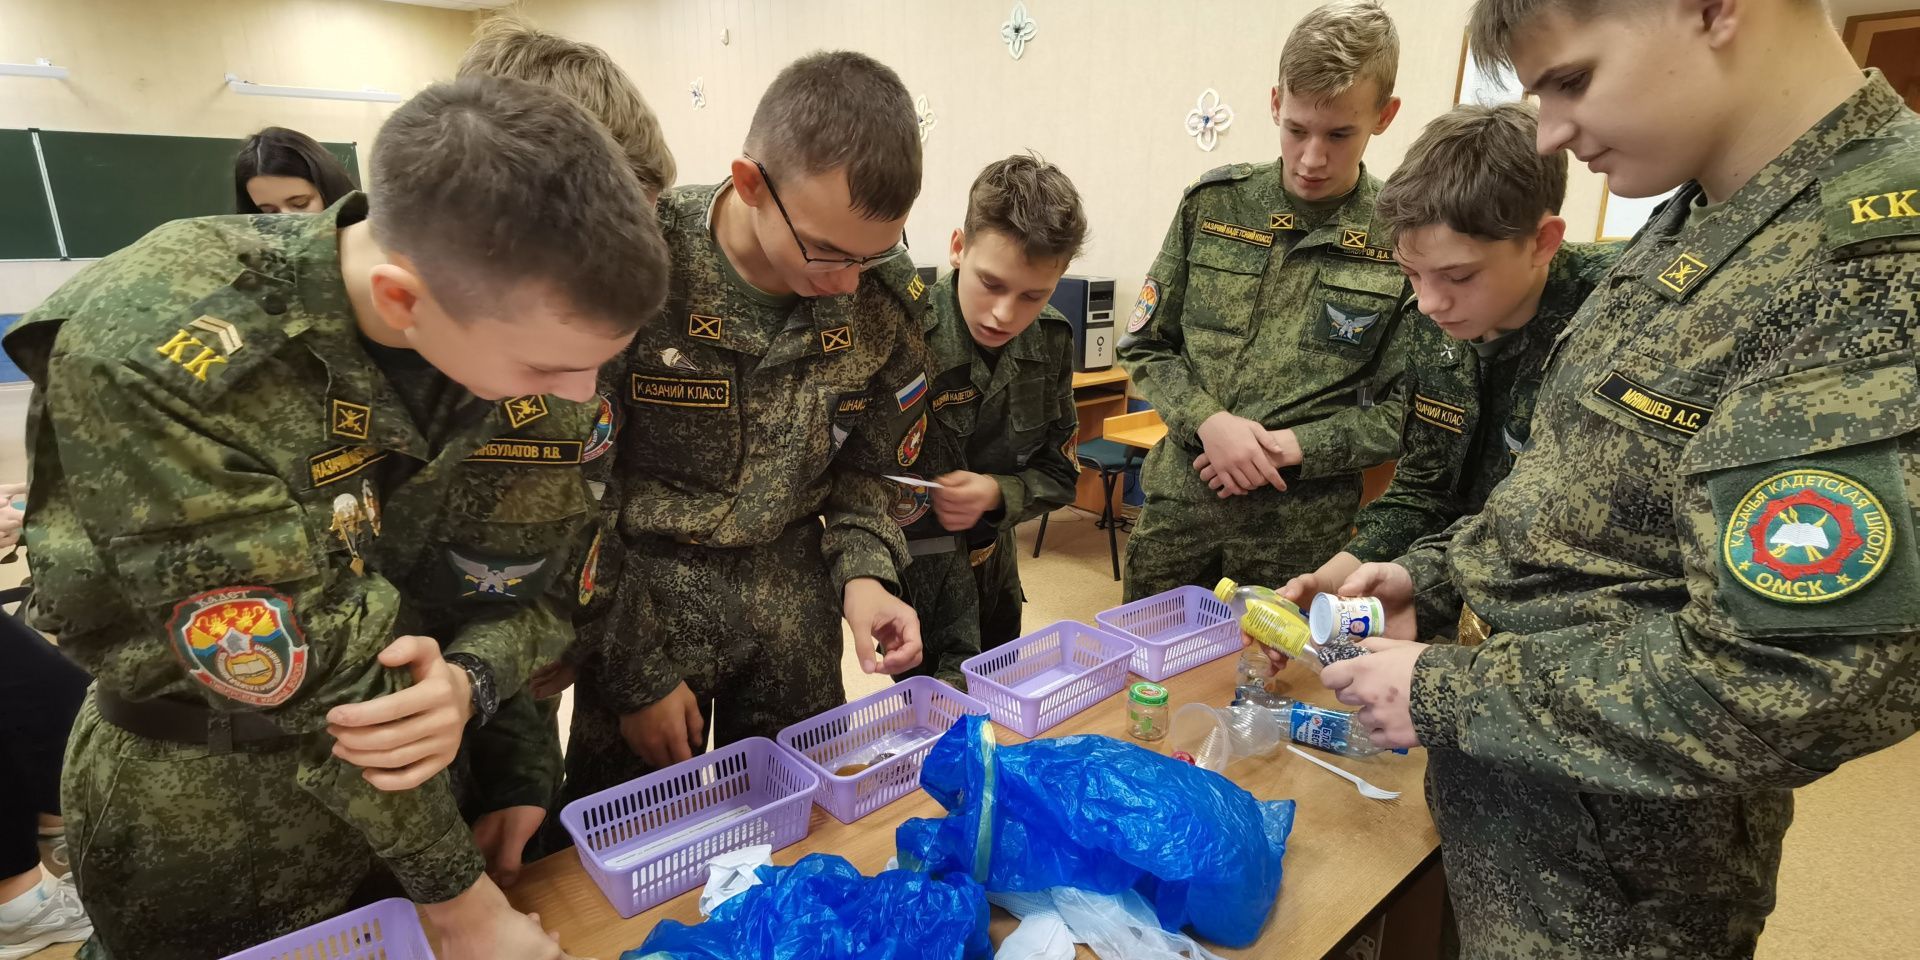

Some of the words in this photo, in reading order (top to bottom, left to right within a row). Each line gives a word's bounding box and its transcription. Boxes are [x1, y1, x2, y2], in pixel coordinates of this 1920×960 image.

[1848, 189, 1920, 224] КК
[907, 273, 926, 300] КК
[156, 328, 227, 382] КК
[637, 381, 684, 398] КАЗАЧИЙ
[687, 386, 724, 400] КЛАСС
[1673, 409, 1701, 429] А.С.
[474, 443, 539, 458] КБУЛАТОВ
[1730, 491, 1768, 547] КАЗАЧЬЯ
[1767, 475, 1870, 510] КАДЕТСКАЯ
[1858, 511, 1886, 565] ШКОЛА
[1756, 572, 1827, 596] ОМСК
